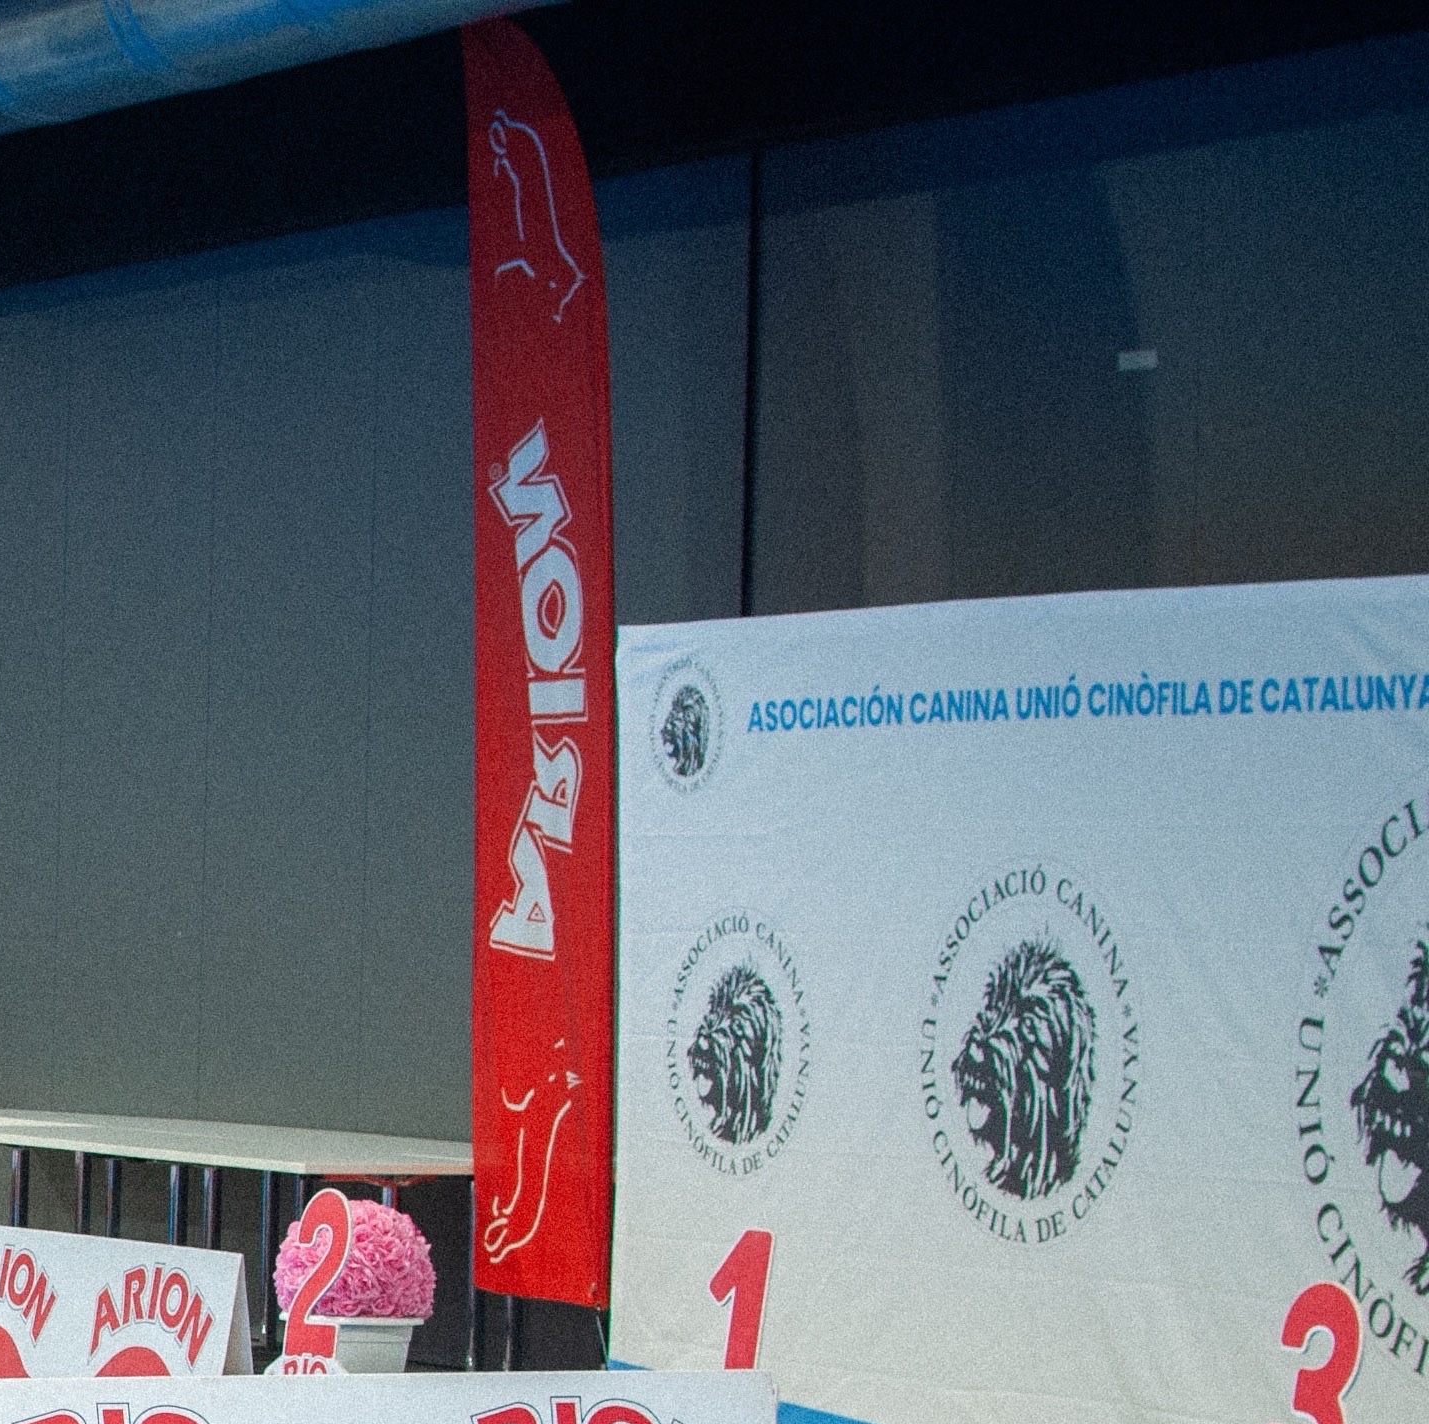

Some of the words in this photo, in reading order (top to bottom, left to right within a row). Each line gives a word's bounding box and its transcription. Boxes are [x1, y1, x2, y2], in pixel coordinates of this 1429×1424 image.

[487, 418, 588, 959] ARION
[747, 685, 904, 733] ASOCIACIÓN
[908, 688, 1010, 724] CANINA
[1015, 673, 1082, 720] UNIÓ
[1088, 671, 1212, 717] CINÒFILA
[1219, 678, 1254, 715] DE
[673, 911, 750, 1003] ASSOCIACIÓ
[755, 921, 804, 1004] CANINA
[931, 863, 1047, 994] ASSOCIACIÓ
[1055, 877, 1129, 999] CANINA
[1318, 797, 1429, 978] ASSOCI
[742, 1150, 764, 1175] DE
[921, 1017, 943, 1121] UNIÓ
[1036, 1210, 1068, 1244] DE
[1072, 1022, 1141, 1219] CATALUNYA
[1295, 1016, 1337, 1186] UNIÓ
[1316, 1202, 1429, 1376] CINÒFI
[89, 1266, 215, 1365] ARION
[283, 1190, 349, 1358] 2
[708, 1229, 773, 1370] 1
